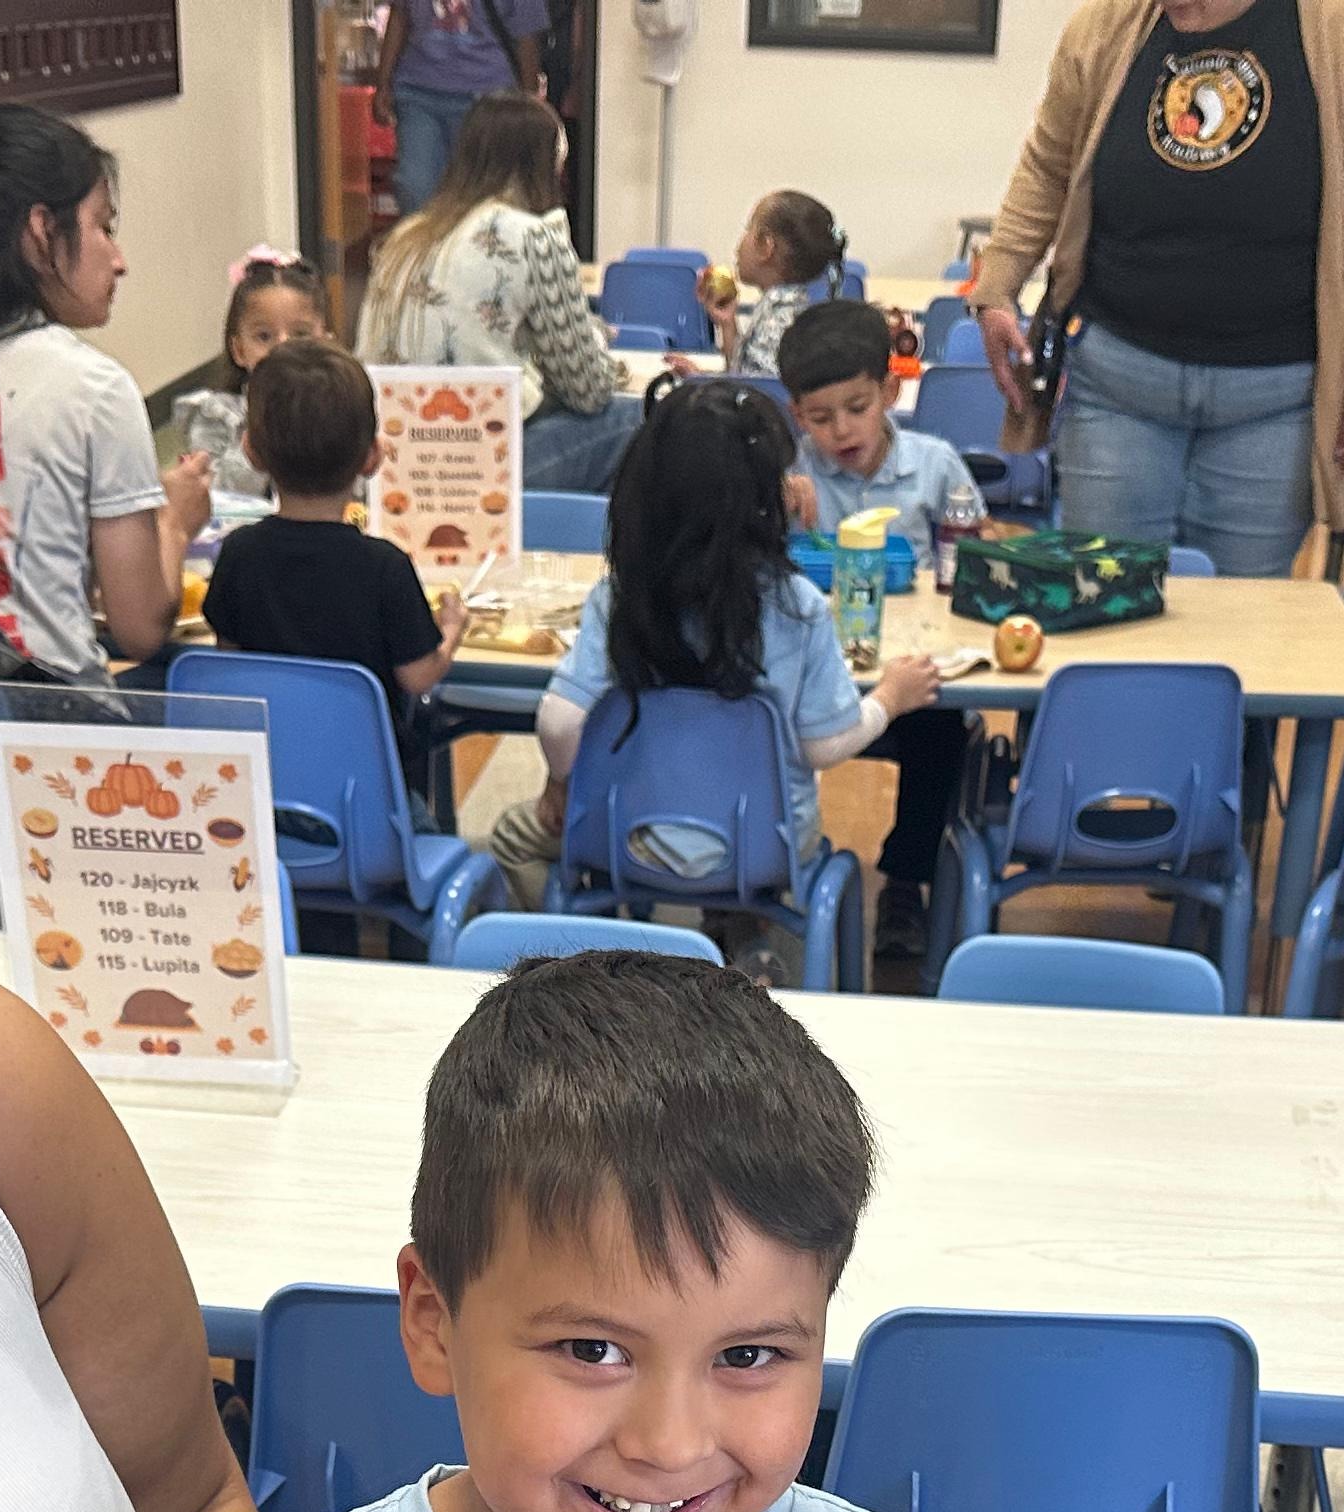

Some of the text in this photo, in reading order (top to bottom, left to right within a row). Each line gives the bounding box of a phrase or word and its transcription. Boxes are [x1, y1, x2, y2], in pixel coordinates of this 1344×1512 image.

[72, 826, 203, 852] RESERVED
[80, 872, 113, 888] 120
[98, 900, 127, 916] 118
[145, 902, 187, 918] Bula
[100, 928, 132, 944] 109
[150, 929, 191, 946] Tate
[97, 955, 125, 971] 115
[142, 957, 200, 977] Lupita
